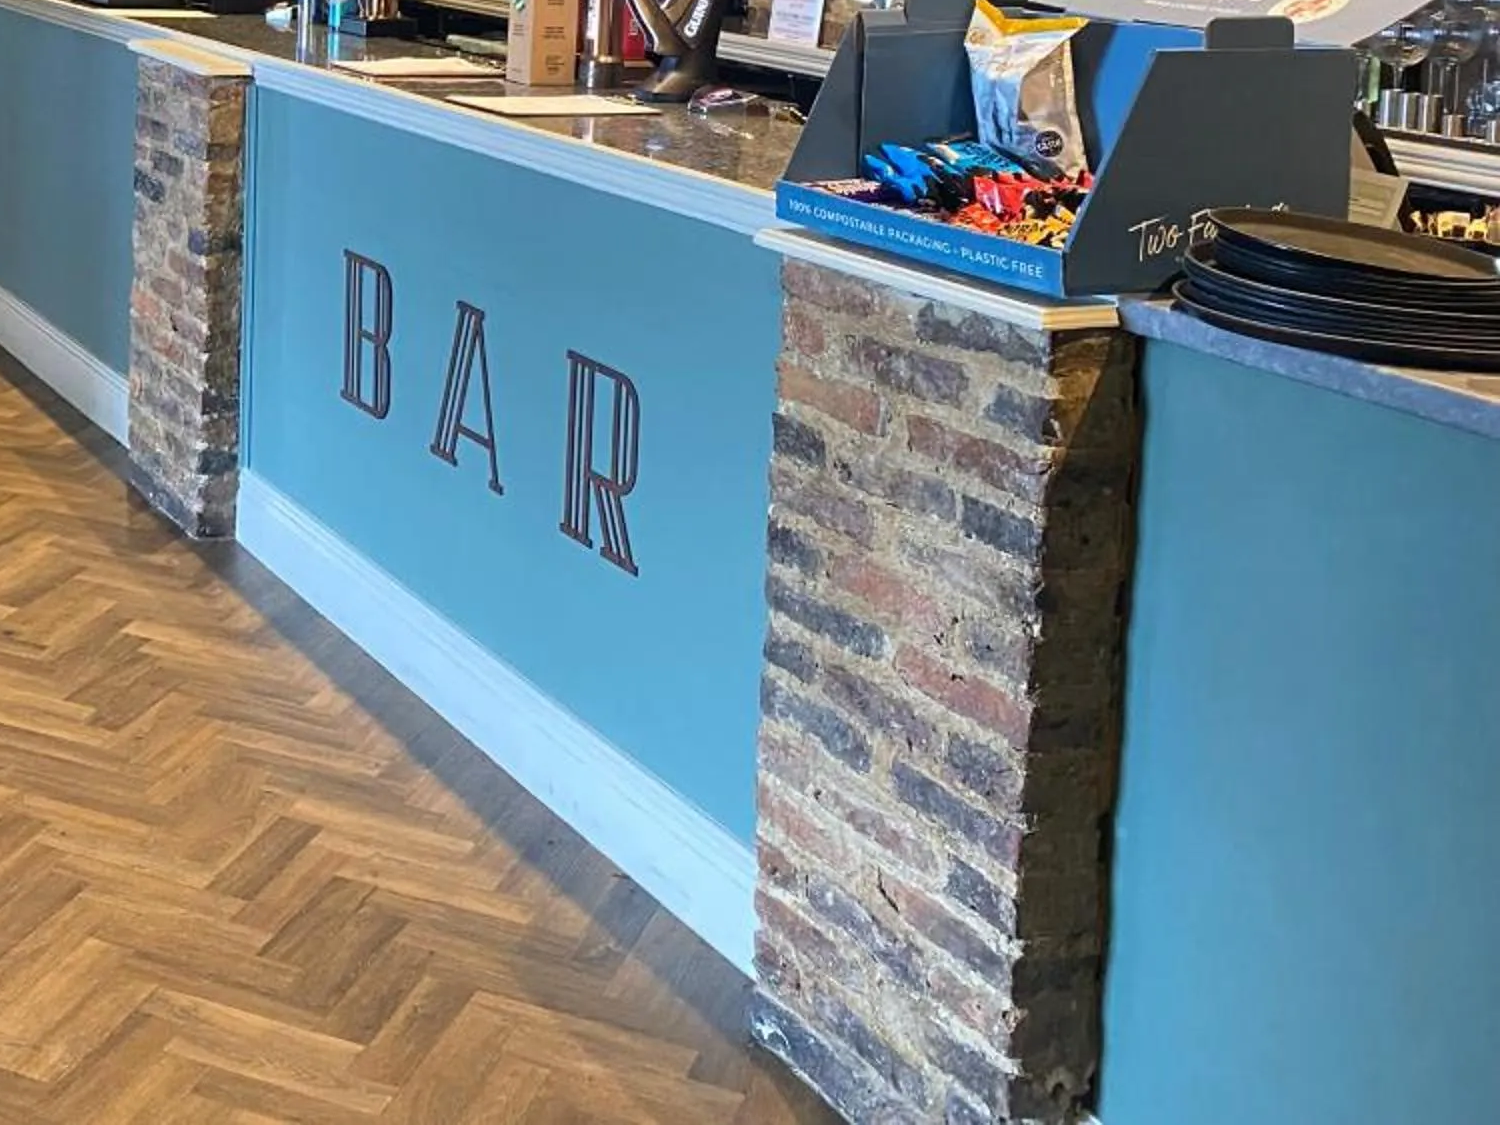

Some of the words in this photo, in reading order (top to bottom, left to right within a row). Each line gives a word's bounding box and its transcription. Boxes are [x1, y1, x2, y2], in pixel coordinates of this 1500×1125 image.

[789, 198, 813, 215] 100%
[813, 207, 885, 238] COMPOSTABLE
[887, 226, 951, 254] PACKAGING
[961, 247, 1009, 271] PLASTIC
[1012, 261, 1044, 280] FREE
[1128, 213, 1184, 263] Two
[340, 248, 640, 577] BAR
